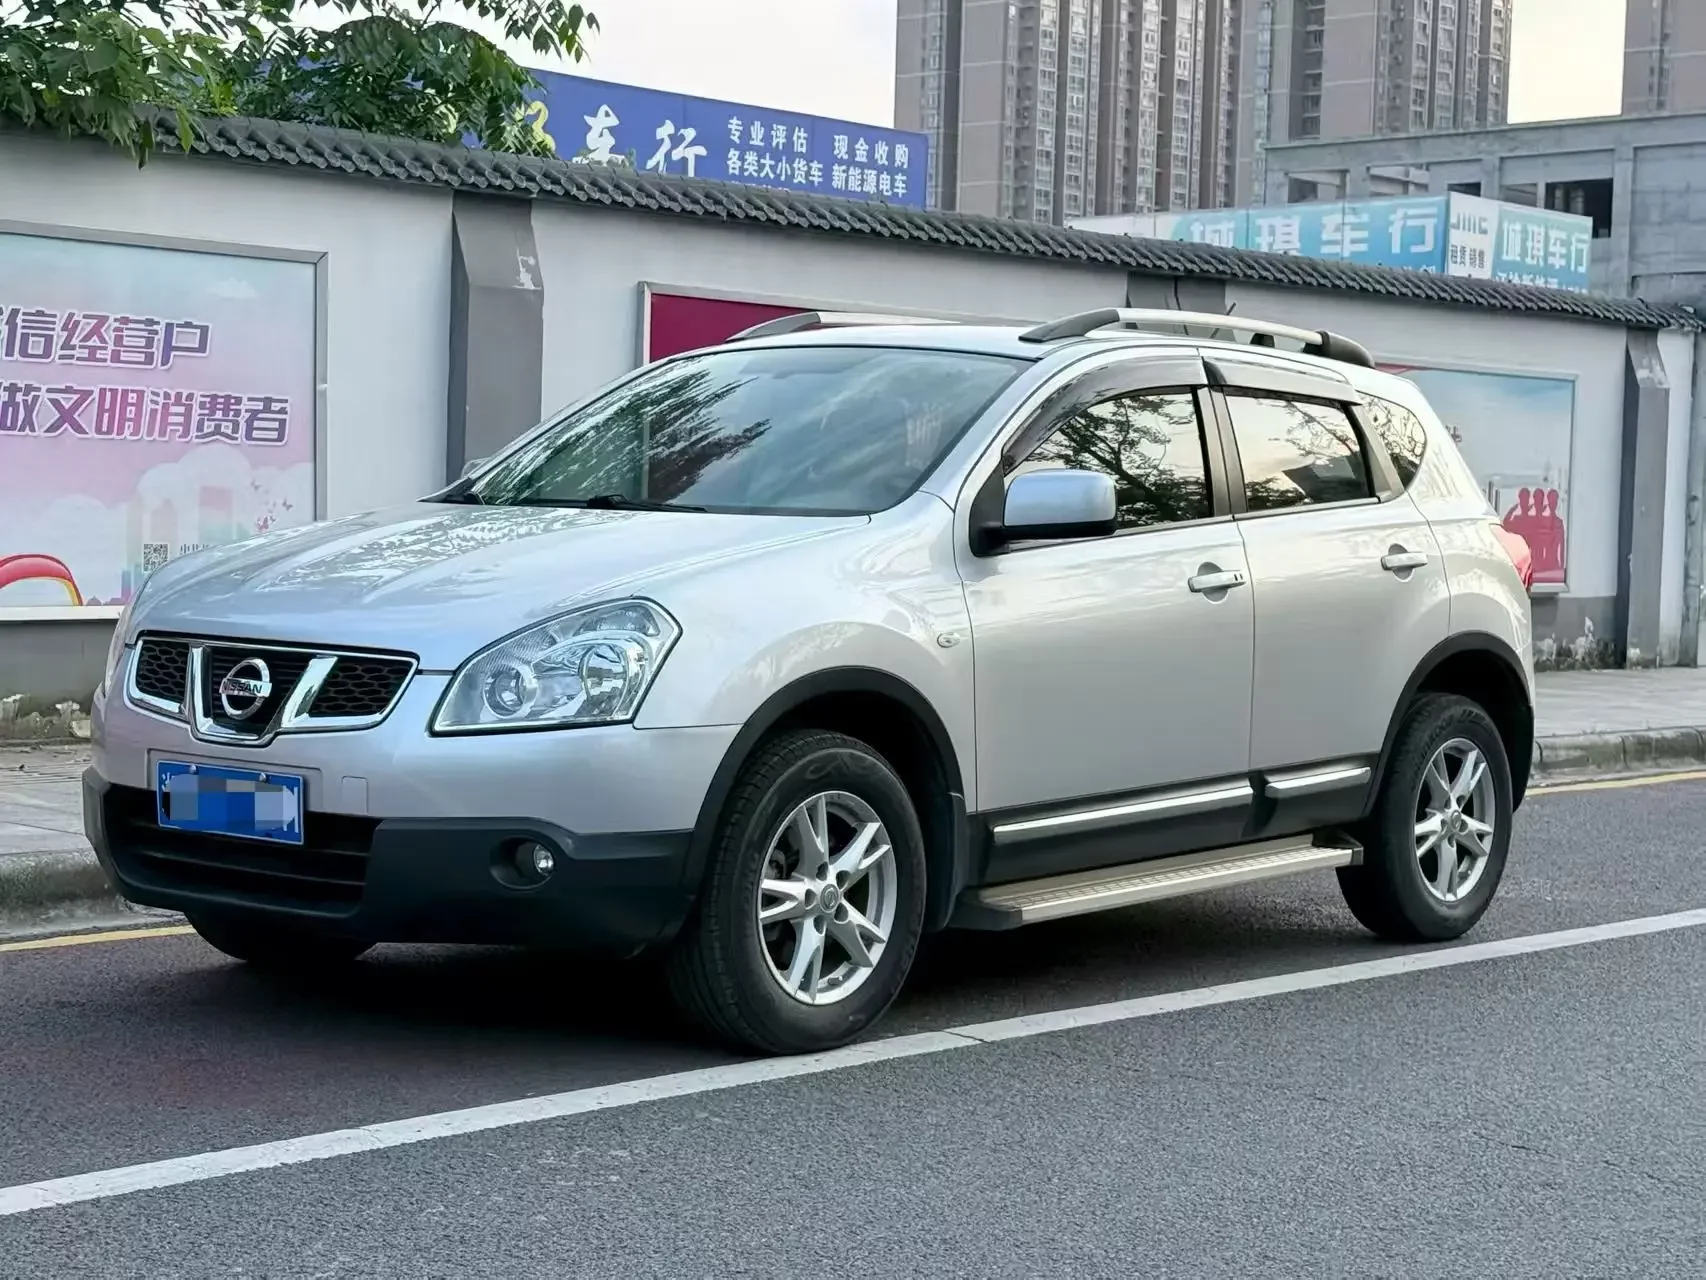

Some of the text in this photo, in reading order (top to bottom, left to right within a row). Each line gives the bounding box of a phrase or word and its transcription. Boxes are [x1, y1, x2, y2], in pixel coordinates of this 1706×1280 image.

[728, 116, 909, 169] 专业评估 现金收购
[727, 148, 908, 198] 各类大小货车 新能源电车
[1501, 219, 1589, 274] 城琪车行
[0, 306, 210, 369] 信经营户
[0, 382, 289, 444] 做文明消费者
